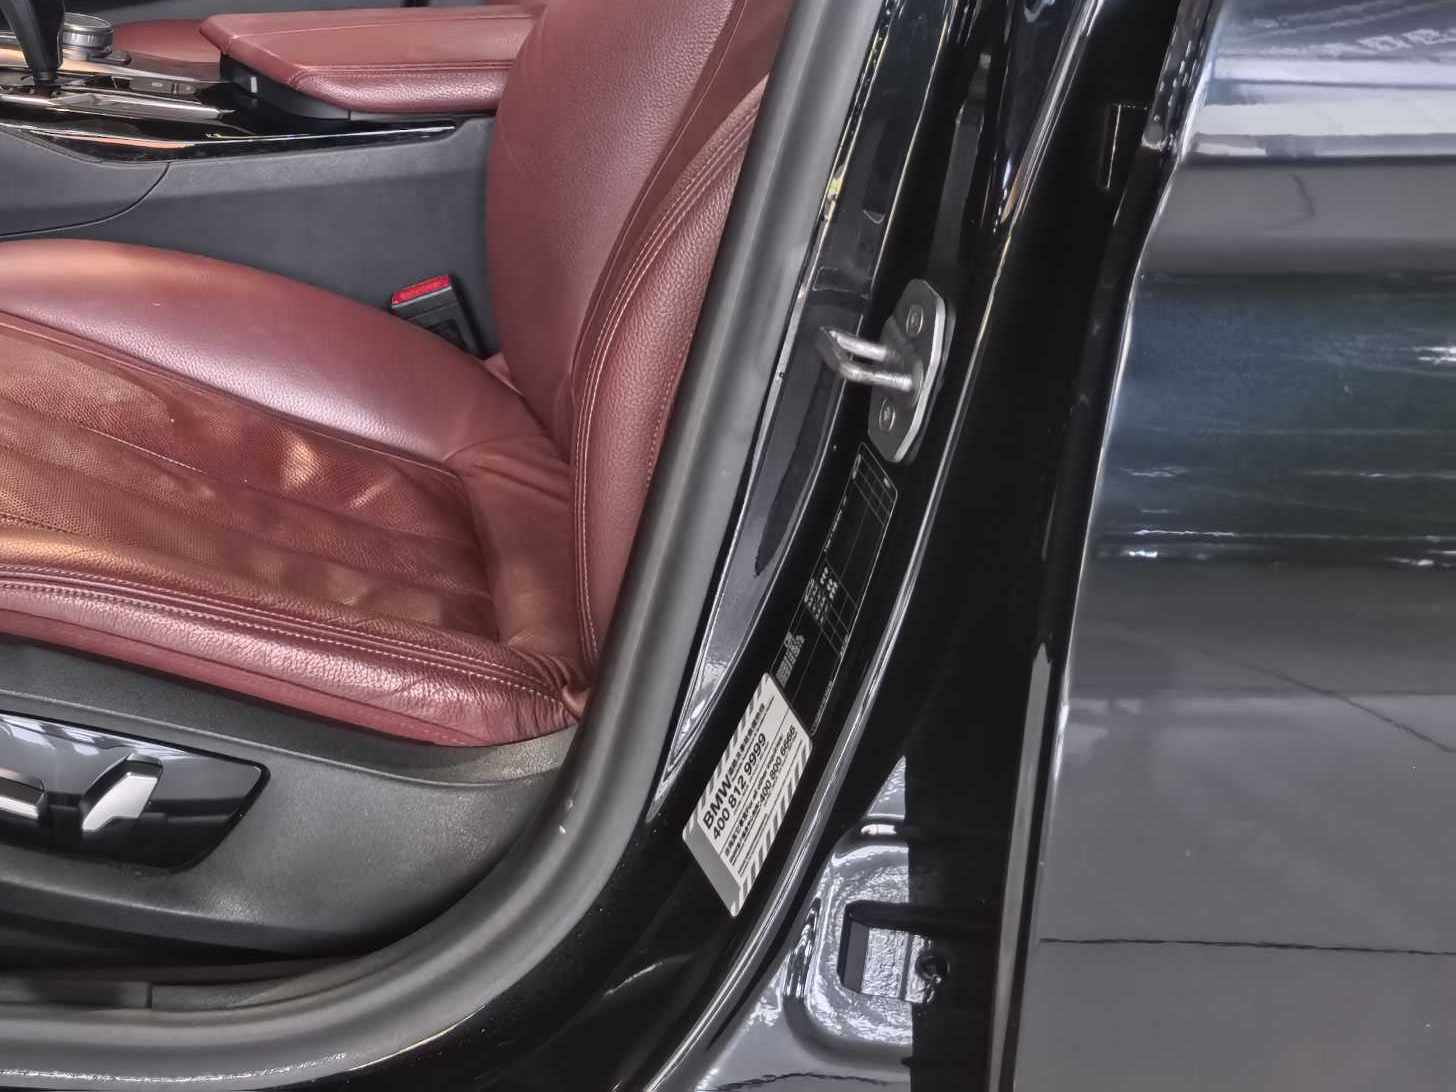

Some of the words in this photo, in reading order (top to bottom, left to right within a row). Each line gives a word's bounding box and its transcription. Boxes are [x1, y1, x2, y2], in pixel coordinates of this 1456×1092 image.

[703, 774, 731, 829] BMW
[714, 808, 730, 839] 400
[728, 775, 746, 808] 812
[744, 733, 765, 775] 9999
[760, 780, 771, 802] 400
[770, 756, 781, 780] 800
